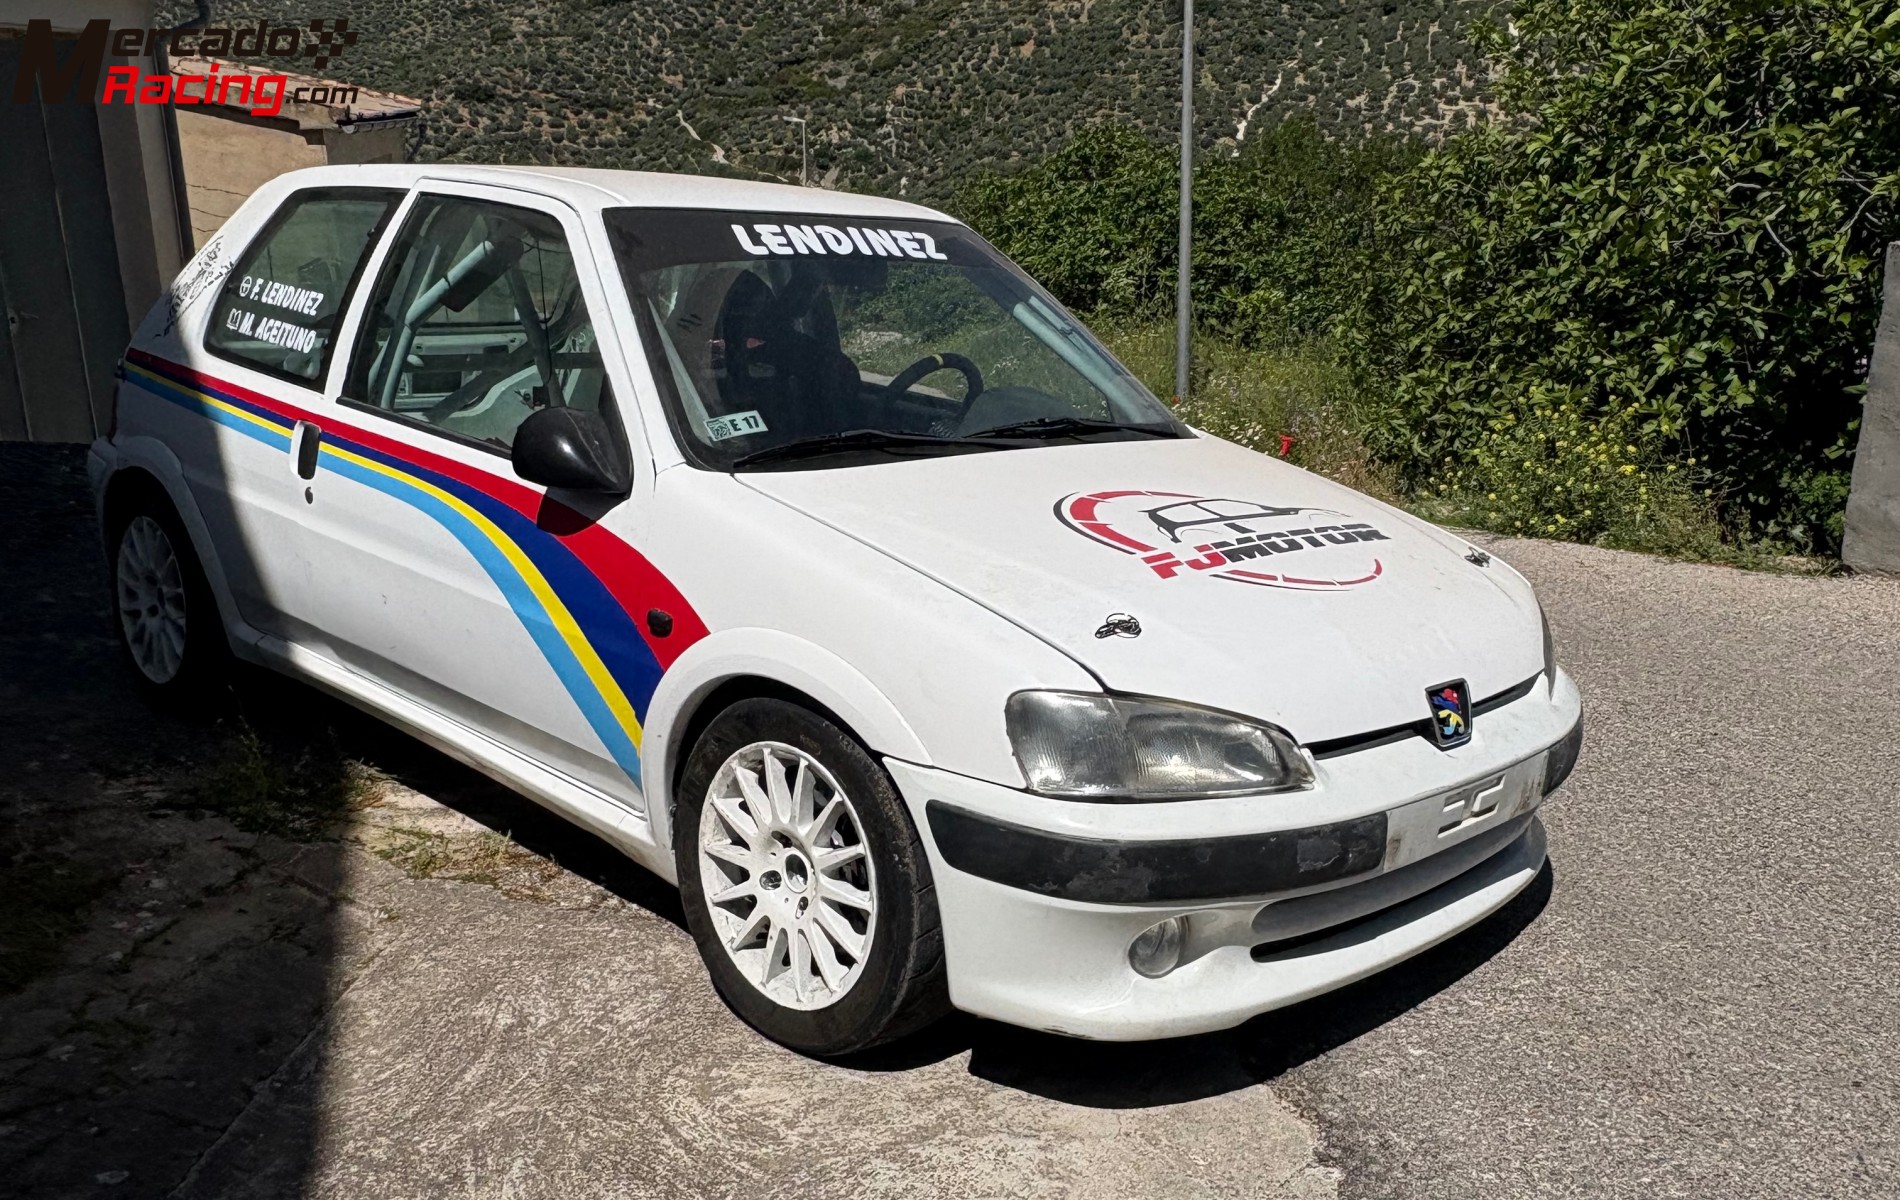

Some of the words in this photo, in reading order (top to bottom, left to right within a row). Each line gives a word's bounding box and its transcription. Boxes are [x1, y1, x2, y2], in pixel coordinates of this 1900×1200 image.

[731, 224, 948, 261] LENDINEZ
[249, 278, 264, 301] F.
[261, 281, 324, 316] LENDINEZ
[238, 312, 255, 337] M.
[254, 317, 317, 354] ACEITUNO
[729, 418, 742, 432] E
[742, 415, 760, 430] 17
